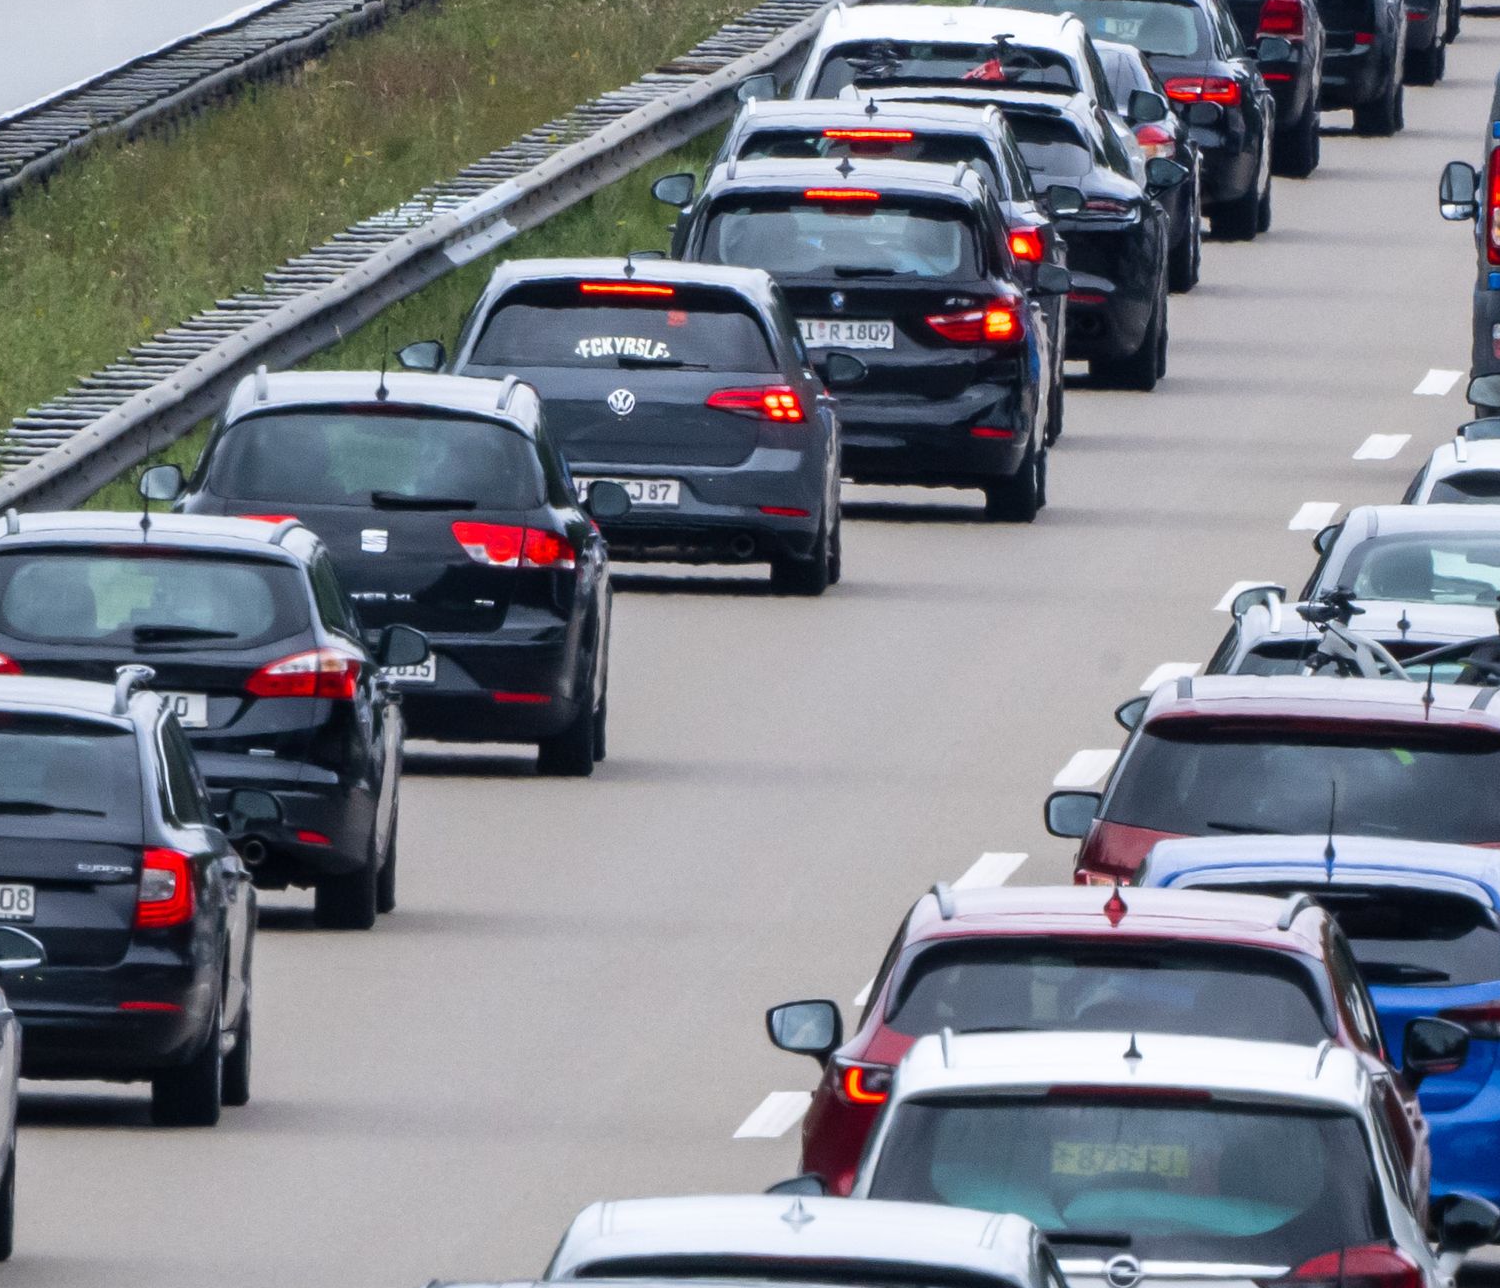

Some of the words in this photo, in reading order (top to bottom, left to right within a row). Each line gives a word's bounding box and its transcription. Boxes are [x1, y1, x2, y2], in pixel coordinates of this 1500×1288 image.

[829, 325, 841, 342] R
[846, 323, 891, 344] 1809
[649, 483, 673, 502] 87
